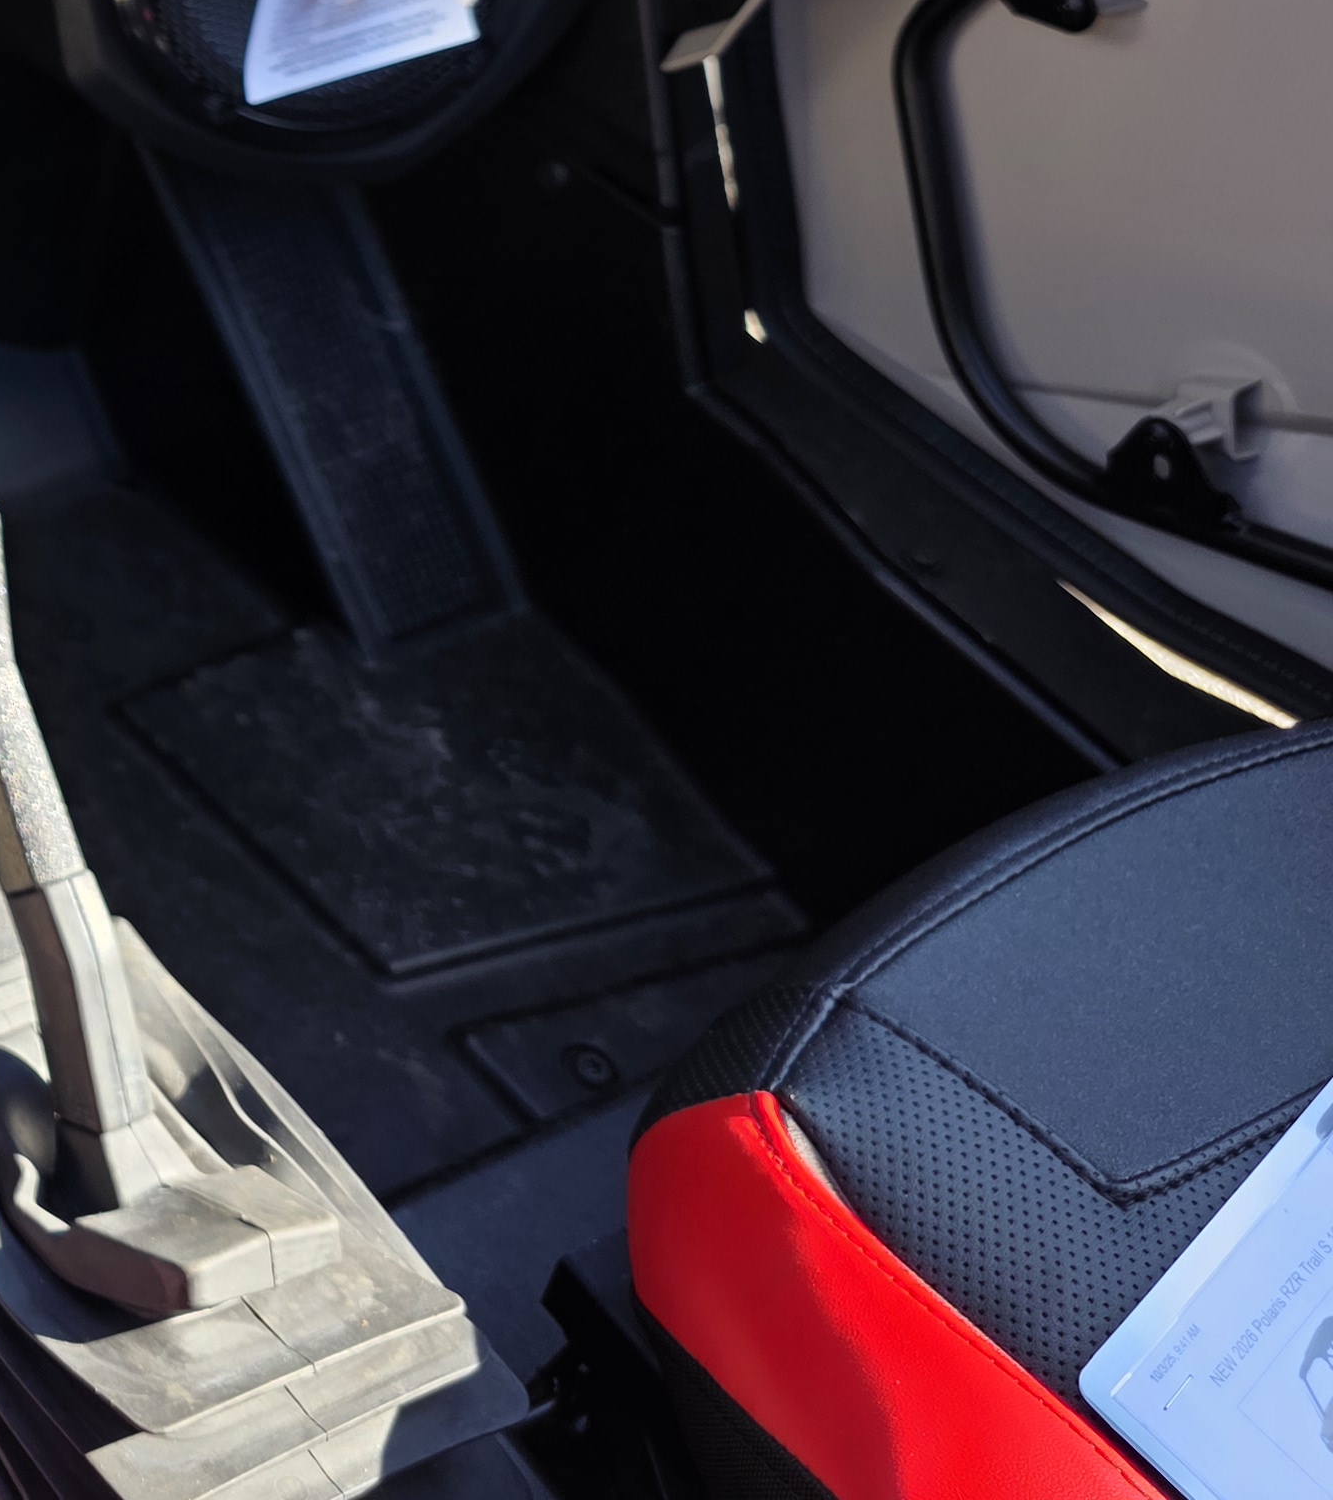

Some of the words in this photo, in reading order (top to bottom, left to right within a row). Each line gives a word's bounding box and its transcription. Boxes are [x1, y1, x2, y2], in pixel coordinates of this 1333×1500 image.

[1208, 1353, 1239, 1388] NEW
[1232, 1328, 1259, 1361] 2026
[1251, 1297, 1287, 1335] Polaris
[1279, 1271, 1307, 1301] RZR
[1298, 1247, 1326, 1276] Trail
[1318, 1240, 1332, 1254] S
